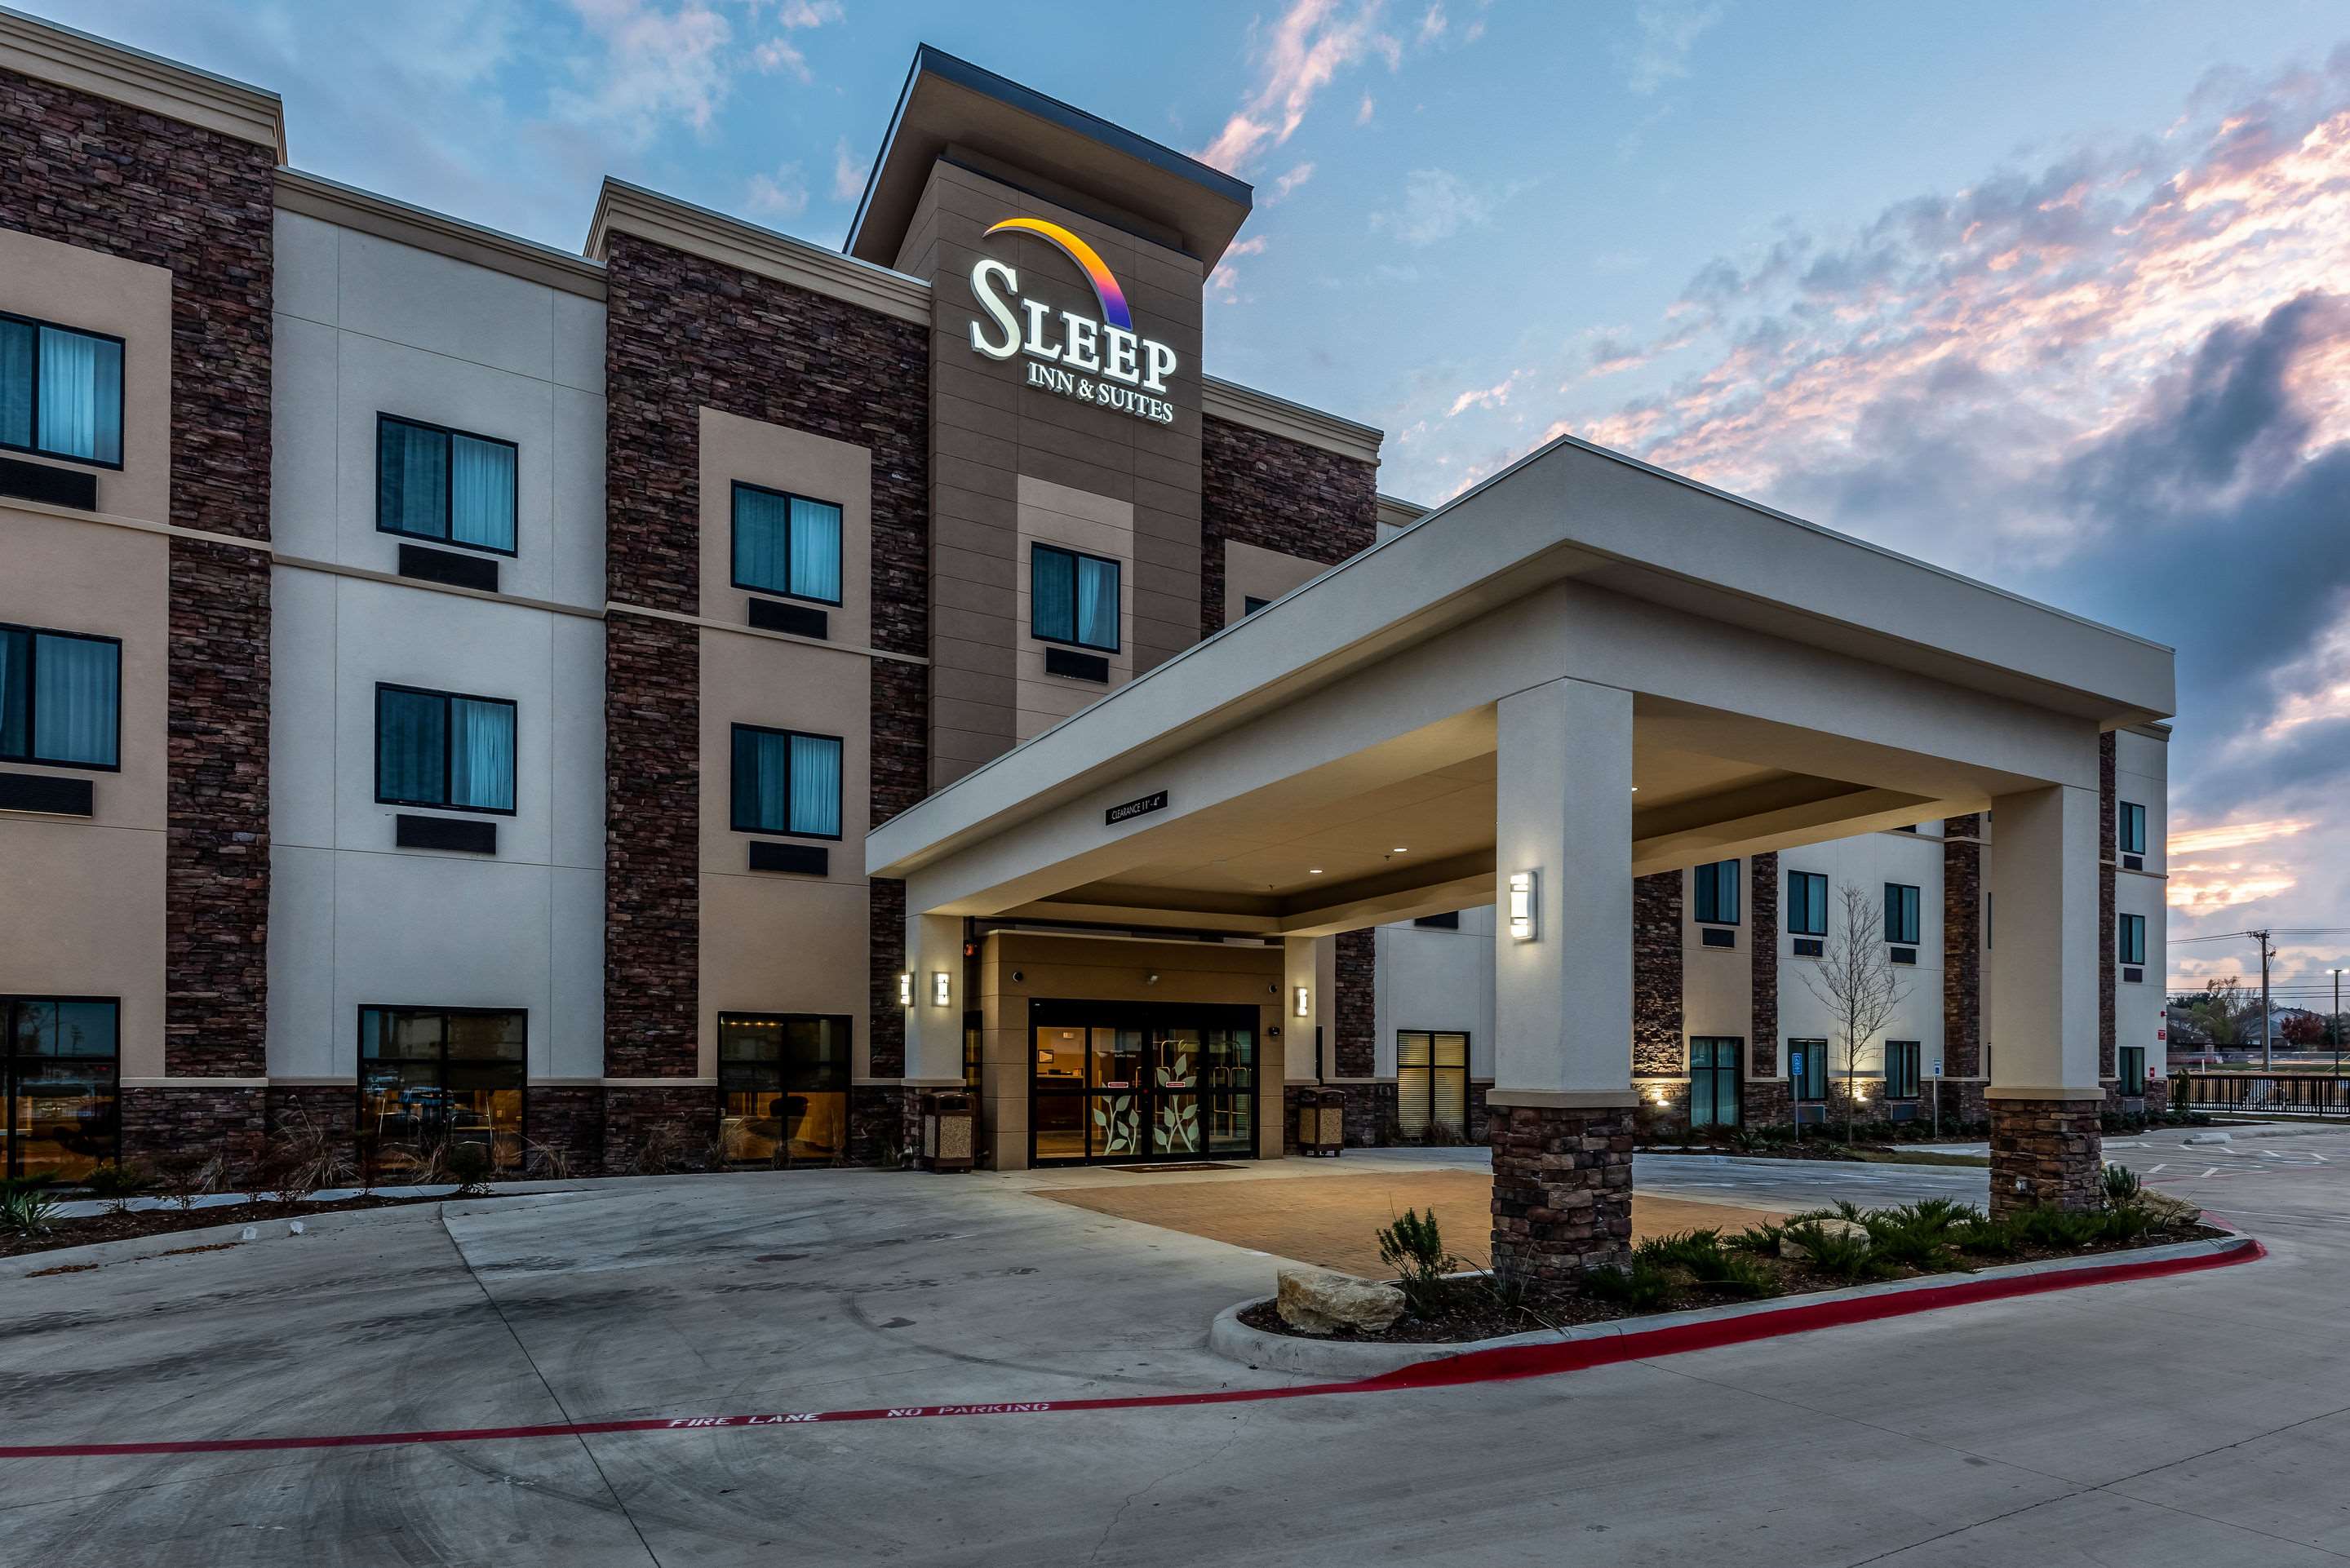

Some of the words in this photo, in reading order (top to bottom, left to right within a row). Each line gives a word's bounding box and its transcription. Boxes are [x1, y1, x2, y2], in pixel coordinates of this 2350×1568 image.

[969, 259, 1177, 395] SLEEP
[1027, 361, 1075, 393] INN
[1076, 379, 1094, 401] &
[1097, 383, 1173, 424] SUITES
[1111, 803, 1141, 820] CLEARANCE
[887, 1408, 924, 1417] NO
[939, 1402, 1051, 1415] PARKING
[669, 1417, 734, 1428] FIRE
[748, 1412, 823, 1424] LANE
